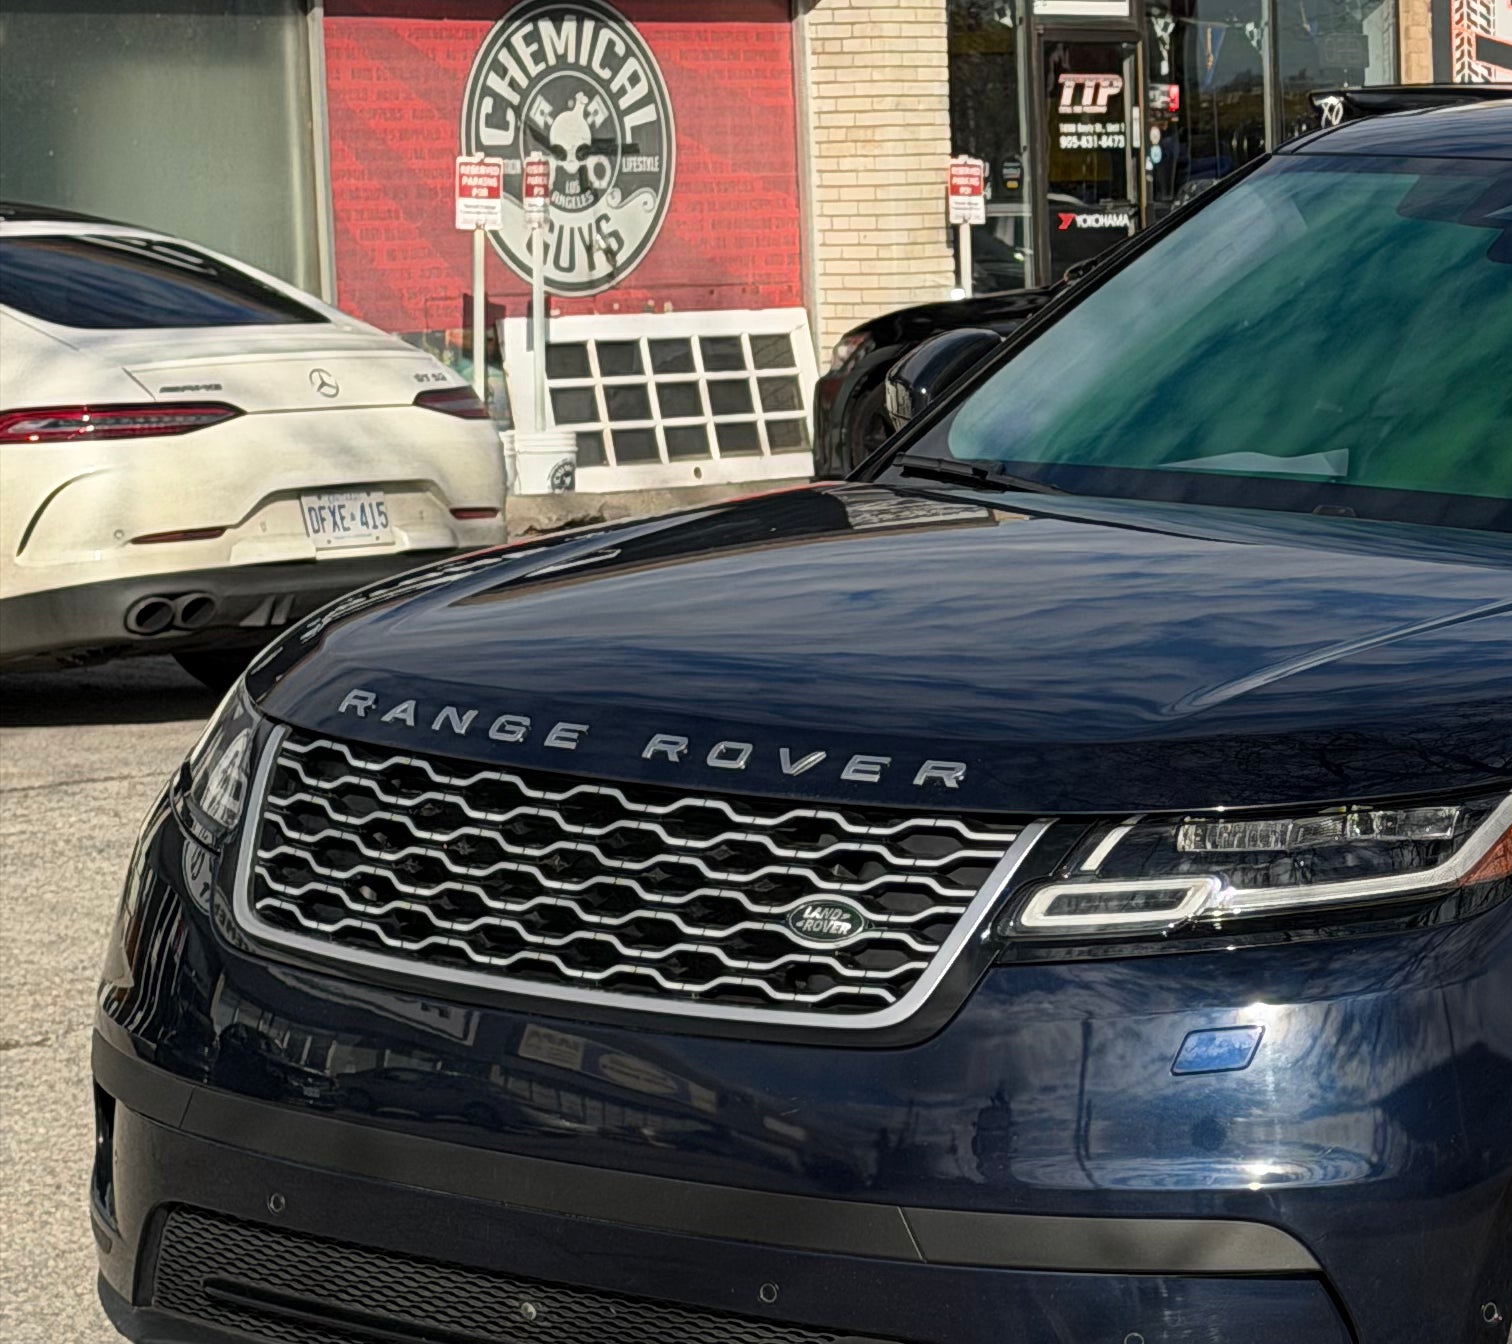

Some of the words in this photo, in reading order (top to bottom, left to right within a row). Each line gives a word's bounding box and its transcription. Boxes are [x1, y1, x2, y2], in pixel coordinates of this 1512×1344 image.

[479, 15, 658, 146] CHEMICAL
[1059, 74, 1123, 107] TTP
[622, 156, 660, 172] LIFESTYLE
[565, 179, 581, 194] LOS
[551, 190, 595, 209] ANGELES
[1075, 214, 1130, 227] YOKOHAMA
[307, 503, 352, 535] DFXE
[360, 501, 389, 529] 415
[338, 687, 590, 750] RANGE
[641, 732, 968, 789] ROVER
[802, 905, 843, 919] LAND
[801, 919, 852, 935] ROVER
